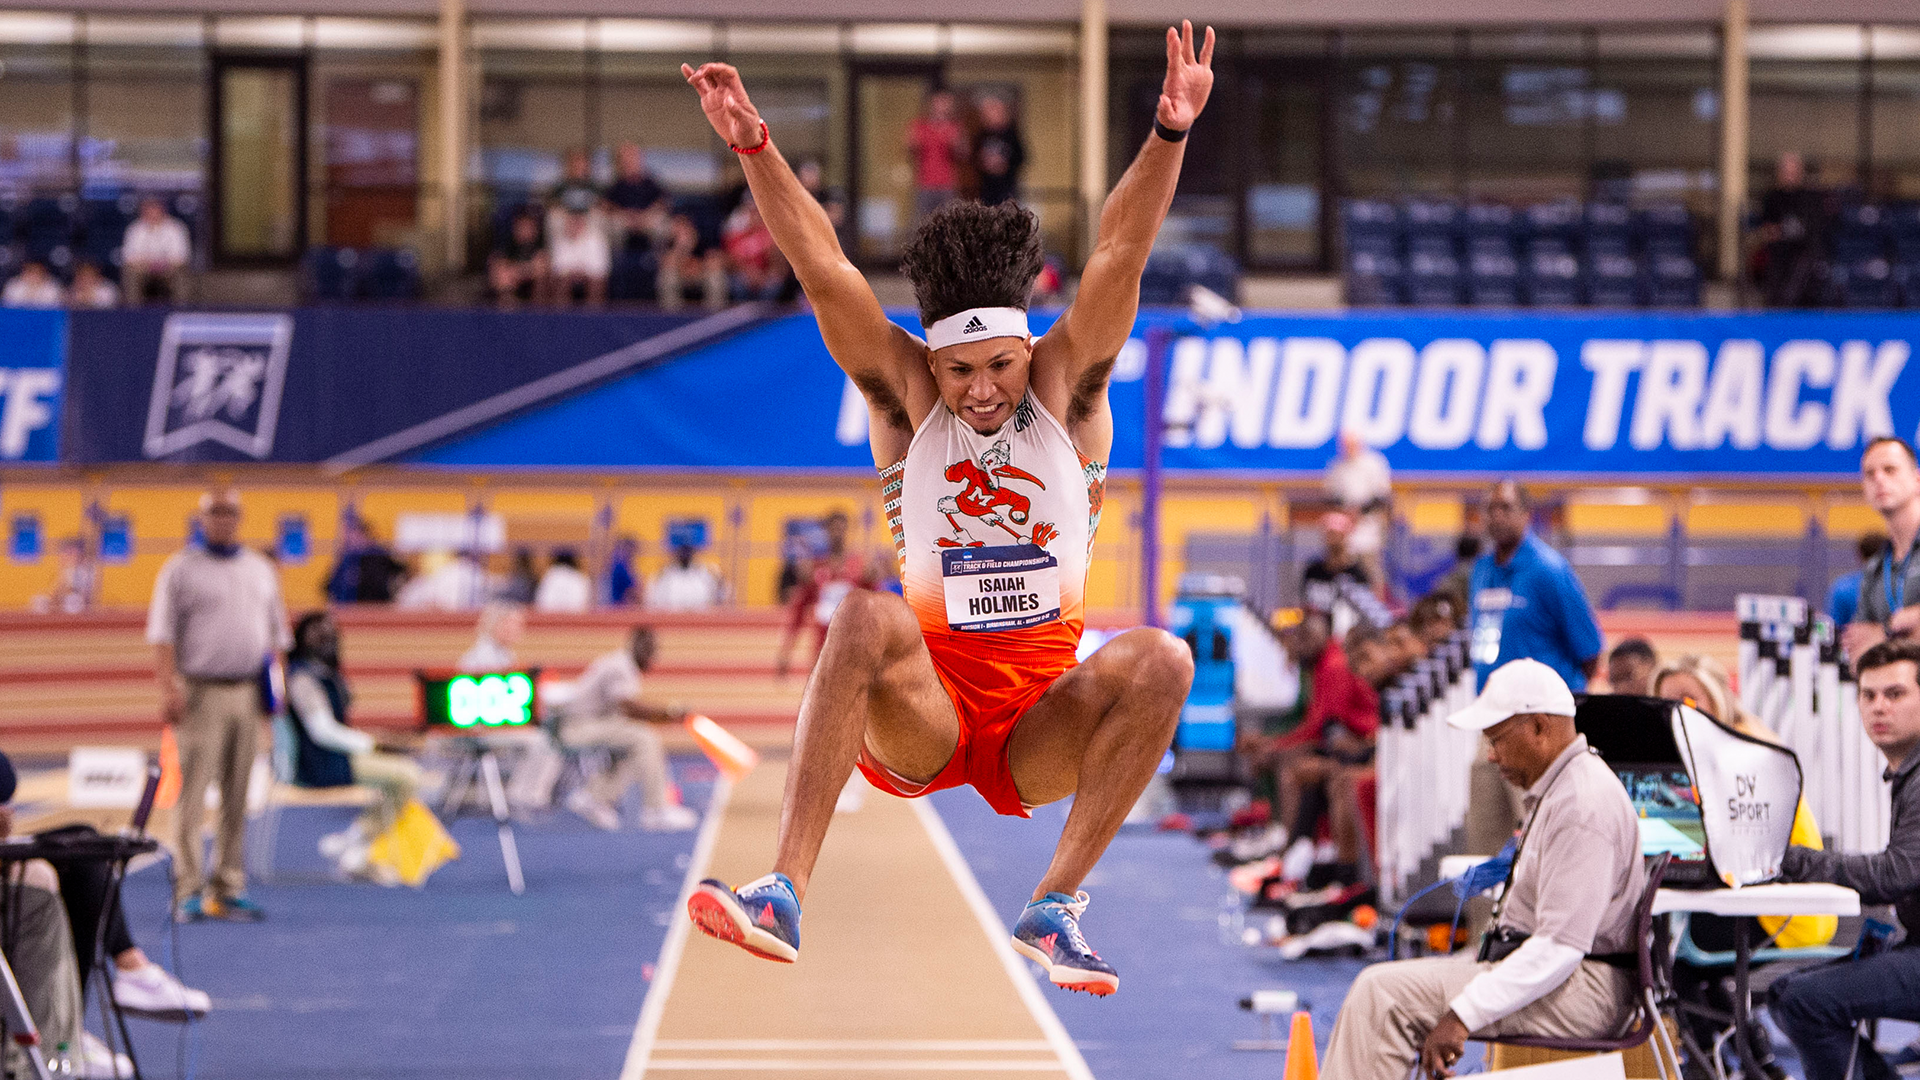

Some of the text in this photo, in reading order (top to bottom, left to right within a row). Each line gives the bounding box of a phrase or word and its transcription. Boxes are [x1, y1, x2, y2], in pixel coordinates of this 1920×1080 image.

[963, 324, 988, 335] adidas
[1162, 337, 1911, 450] INDOOR TRACK
[0, 368, 59, 458] F
[967, 486, 995, 506] M
[963, 561, 980, 570] TRACK
[986, 561, 1002, 569] FIELD
[1003, 556, 1050, 568] CHAMPIONSHIPS
[978, 577, 1026, 593] ISAIAH
[968, 592, 1040, 616] HOLMES
[1735, 773, 1757, 797] DV
